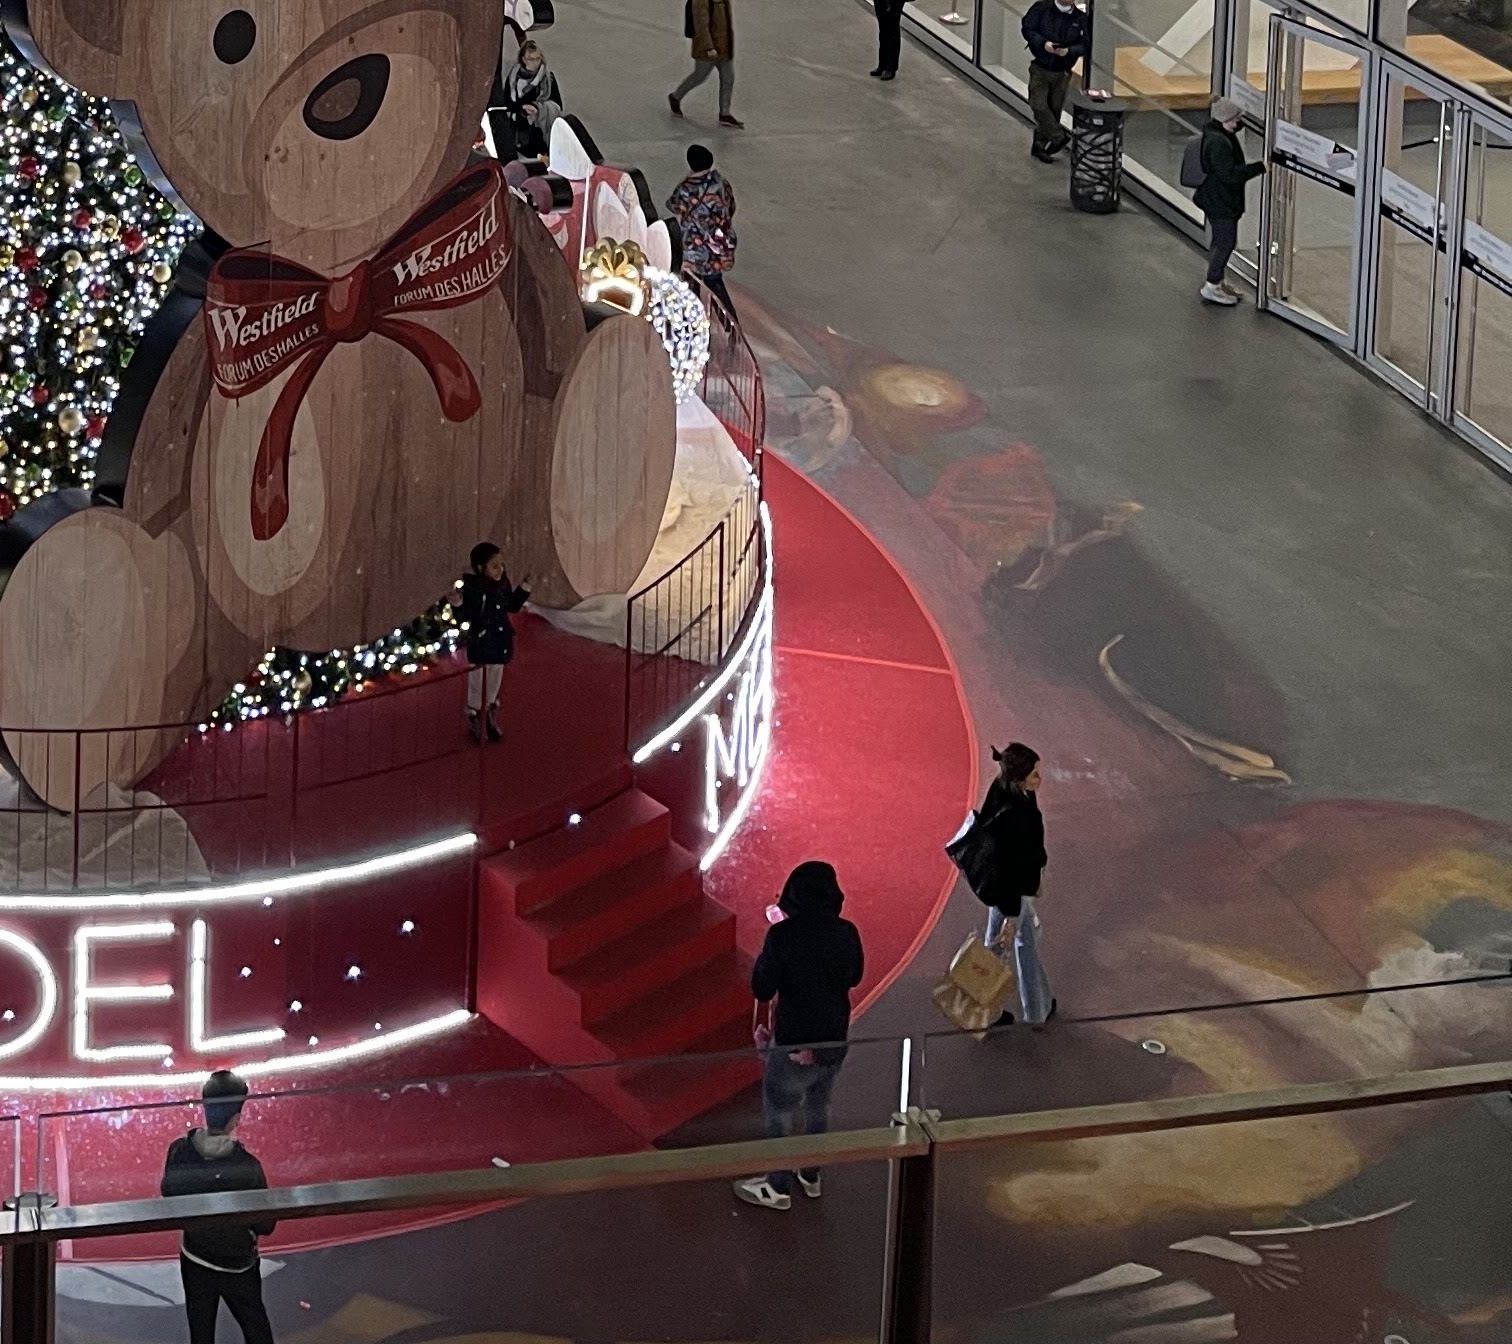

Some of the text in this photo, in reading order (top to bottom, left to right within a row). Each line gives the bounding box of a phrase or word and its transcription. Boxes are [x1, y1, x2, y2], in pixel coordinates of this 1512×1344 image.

[392, 197, 500, 287] Westfield
[394, 243, 506, 308] FORUM DES HALLES
[207, 291, 321, 353] Westfield
[217, 323, 320, 384] FORUM DES HALLES
